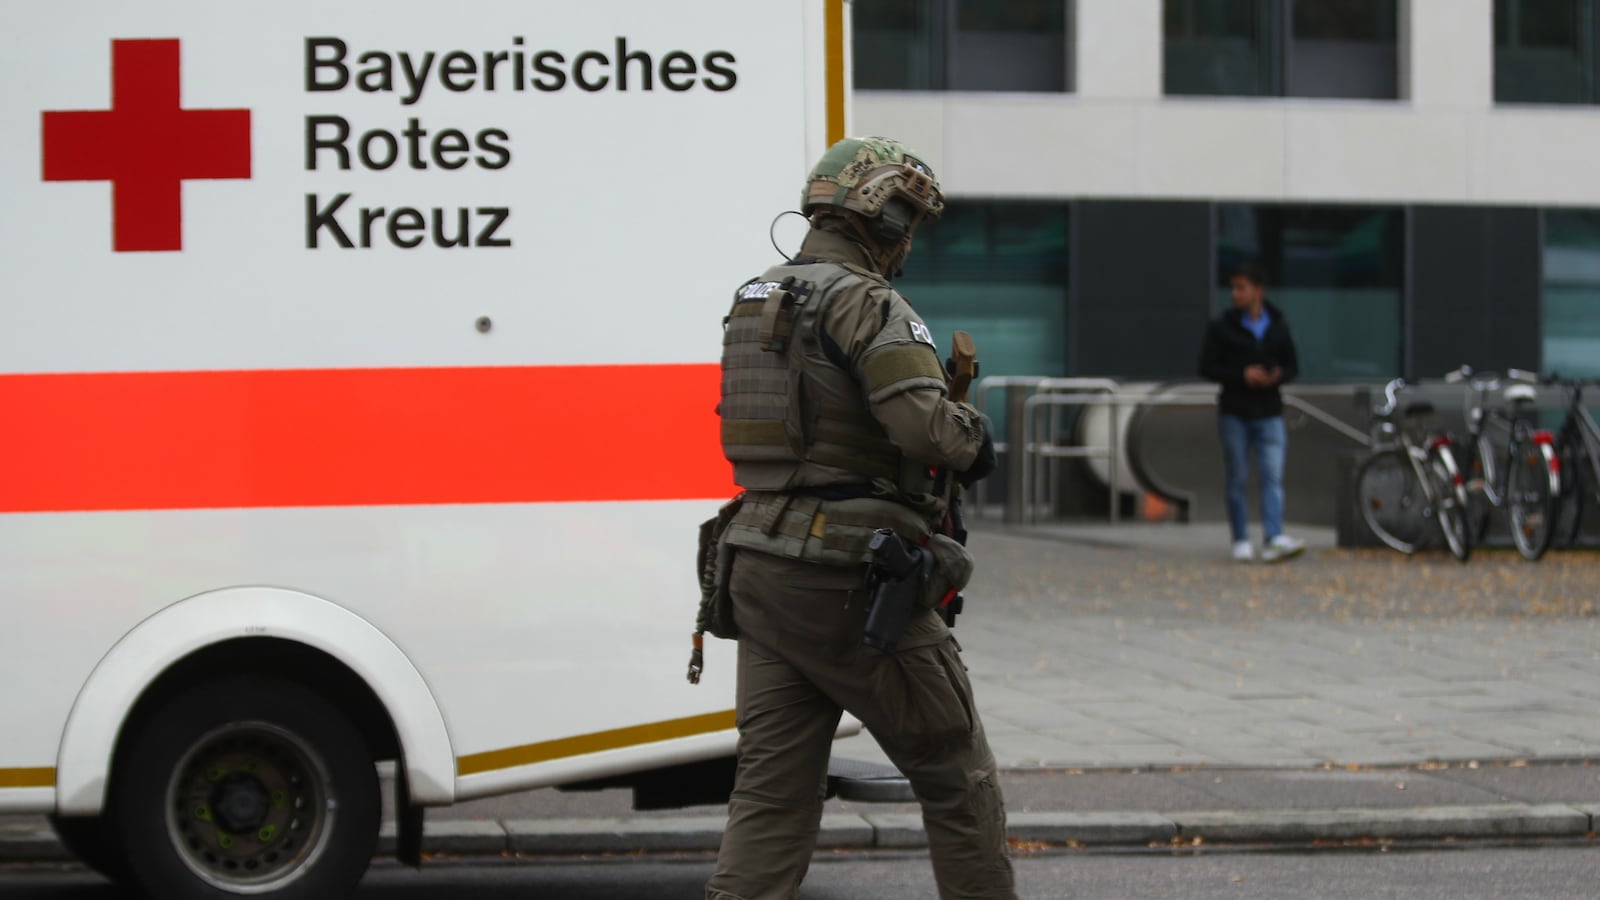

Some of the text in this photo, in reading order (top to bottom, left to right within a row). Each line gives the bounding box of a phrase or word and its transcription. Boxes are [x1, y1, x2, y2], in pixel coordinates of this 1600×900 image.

[305, 36, 738, 106] Bayerisches
[305, 114, 511, 171] Rotes
[305, 193, 512, 249] Kreuz
[909, 320, 934, 346] PO
